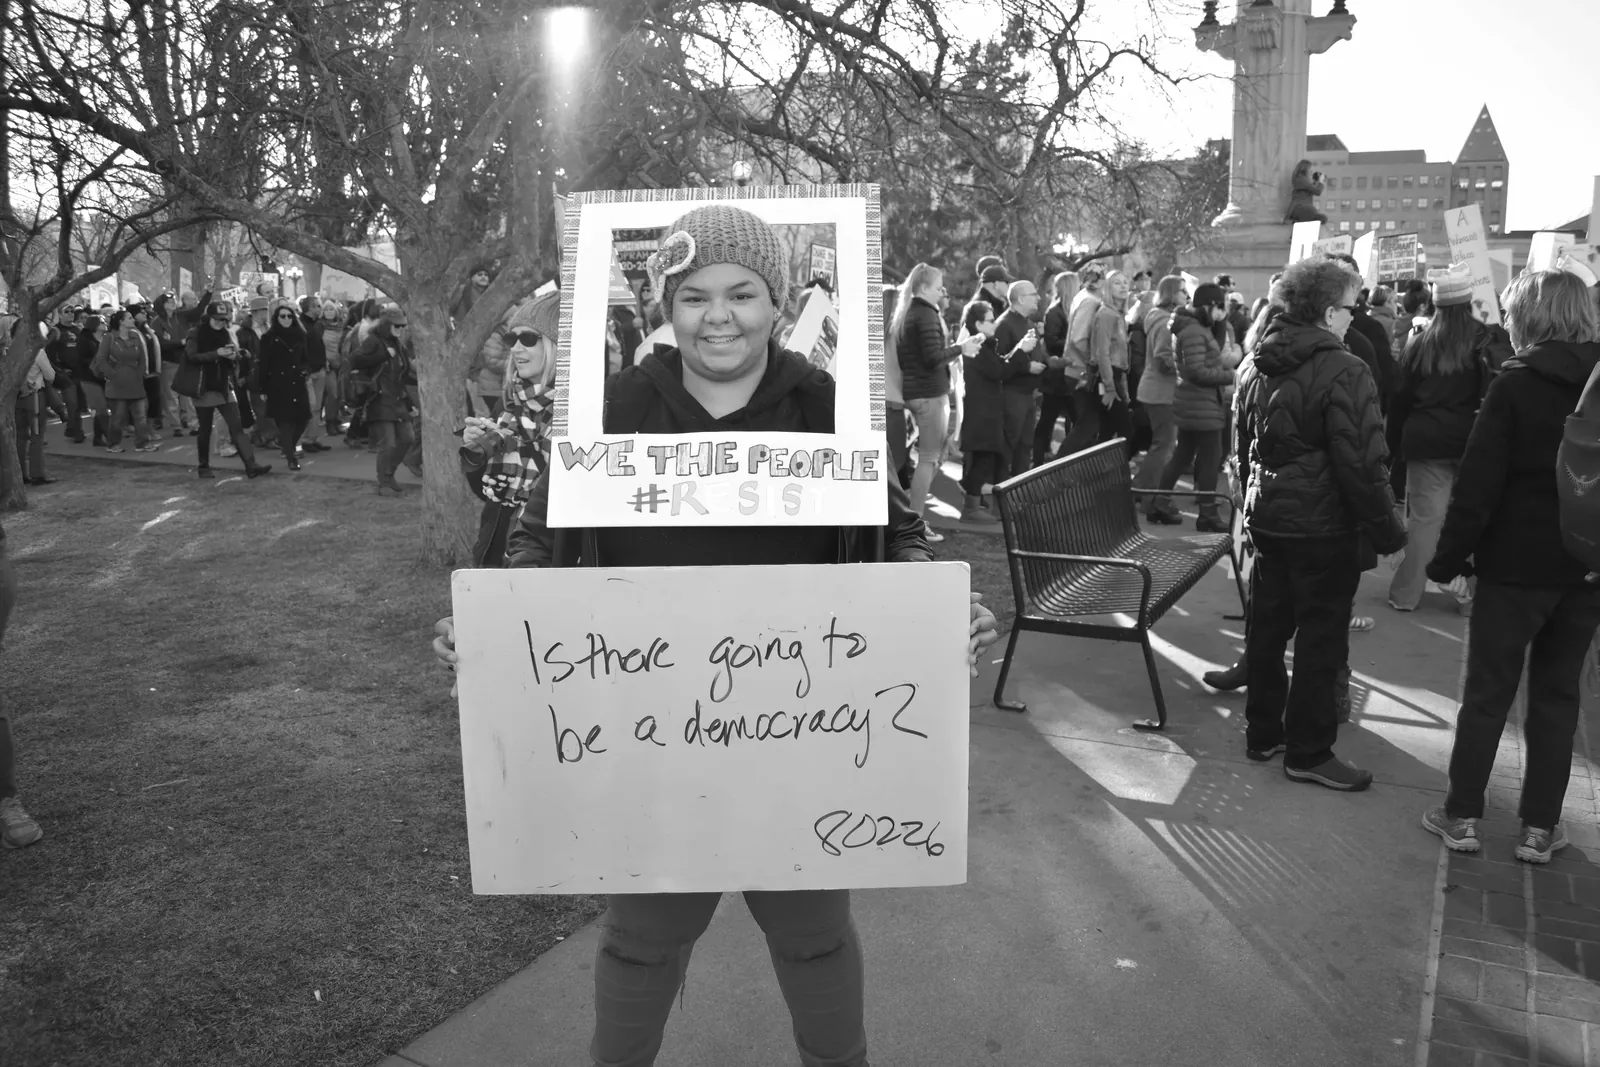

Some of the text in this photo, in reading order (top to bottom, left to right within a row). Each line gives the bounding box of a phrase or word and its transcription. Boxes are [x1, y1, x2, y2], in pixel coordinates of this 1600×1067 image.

[1456, 209, 1469, 226] A
[557, 439, 879, 481] WE THE PEOPLE
[523, 616, 867, 703] Is there going to
[547, 703, 608, 764] be
[634, 715, 666, 748] a
[813, 809, 946, 857] 80226
